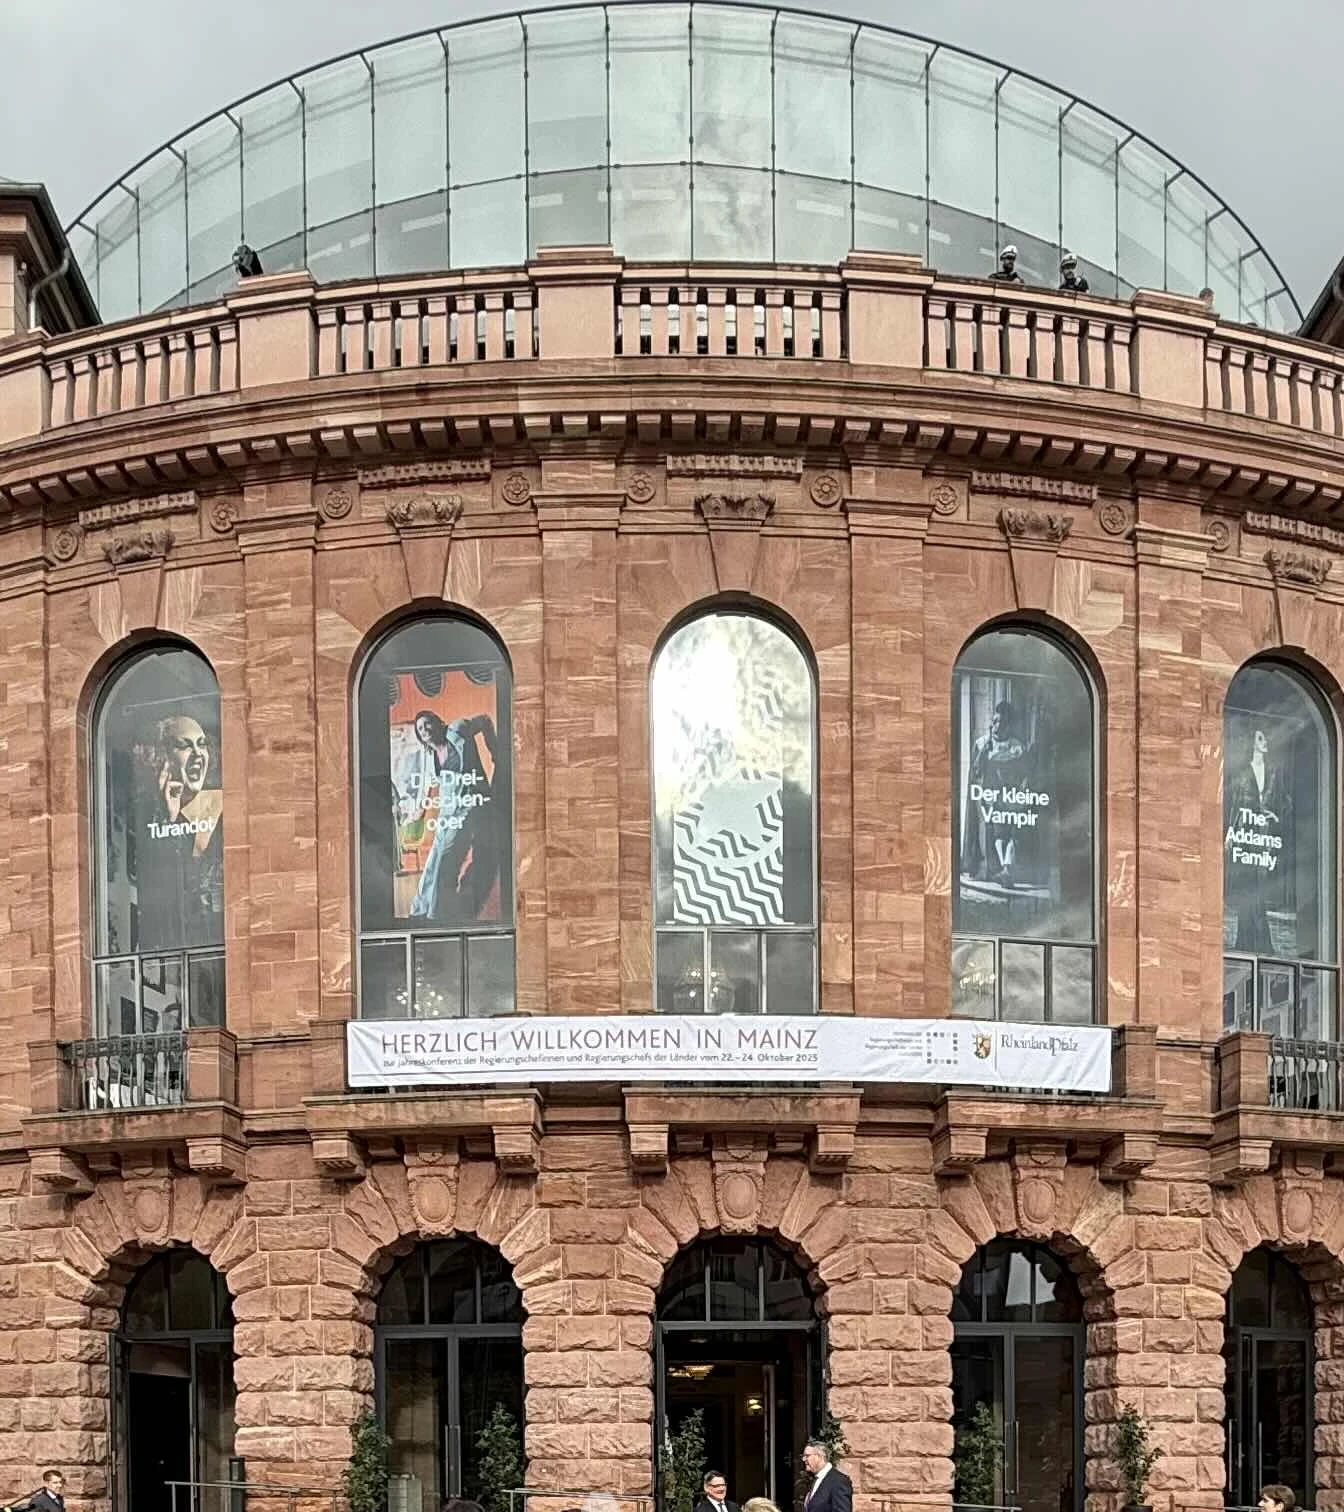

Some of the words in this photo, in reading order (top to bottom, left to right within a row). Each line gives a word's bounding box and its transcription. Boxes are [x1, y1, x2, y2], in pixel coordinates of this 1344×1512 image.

[440, 768, 484, 786] Drei-
[970, 784, 1000, 802] Der
[1002, 786, 1050, 806] kleine
[147, 815, 217, 839] Turandot
[426, 815, 466, 832] oper
[980, 805, 1039, 829] Vampir
[1239, 807, 1266, 827] The
[1225, 826, 1282, 849] Addams
[1232, 846, 1277, 871] Family
[382, 1031, 497, 1054] HERZLICH
[510, 1028, 681, 1051] WILLKOMMEN
[697, 1028, 722, 1049] IN
[737, 1028, 818, 1049] MAINZ
[567, 1053, 583, 1062] und
[655, 1053, 668, 1062] der
[670, 1052, 697, 1062] Länder
[701, 1054, 719, 1062] vom
[757, 1053, 794, 1062] Oktober
